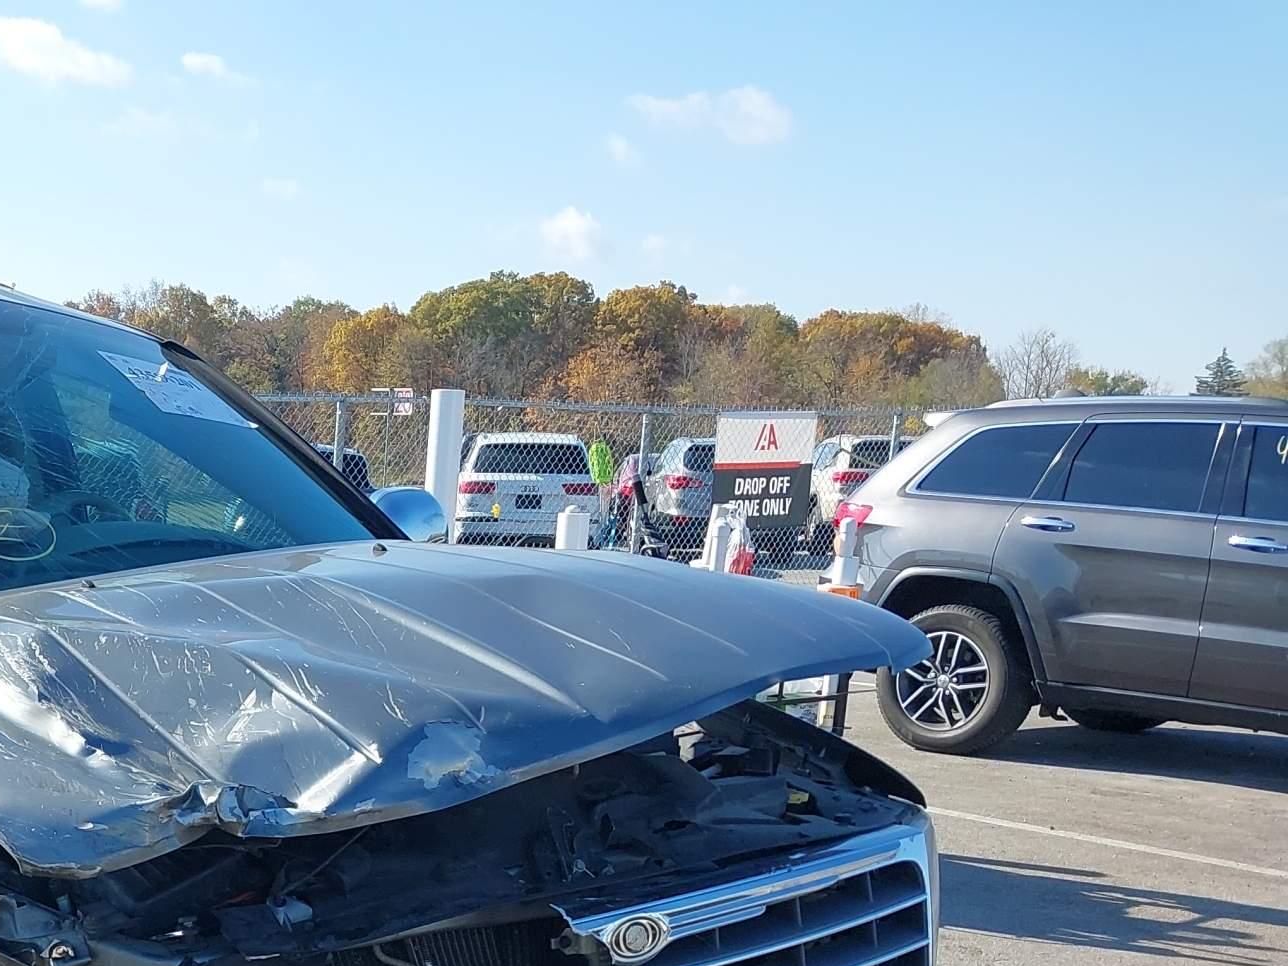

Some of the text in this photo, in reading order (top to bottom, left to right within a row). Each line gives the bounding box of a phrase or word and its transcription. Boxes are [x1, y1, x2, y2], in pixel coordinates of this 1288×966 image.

[735, 477, 791, 495] DROP OFF
[762, 498, 792, 516] ONLY
